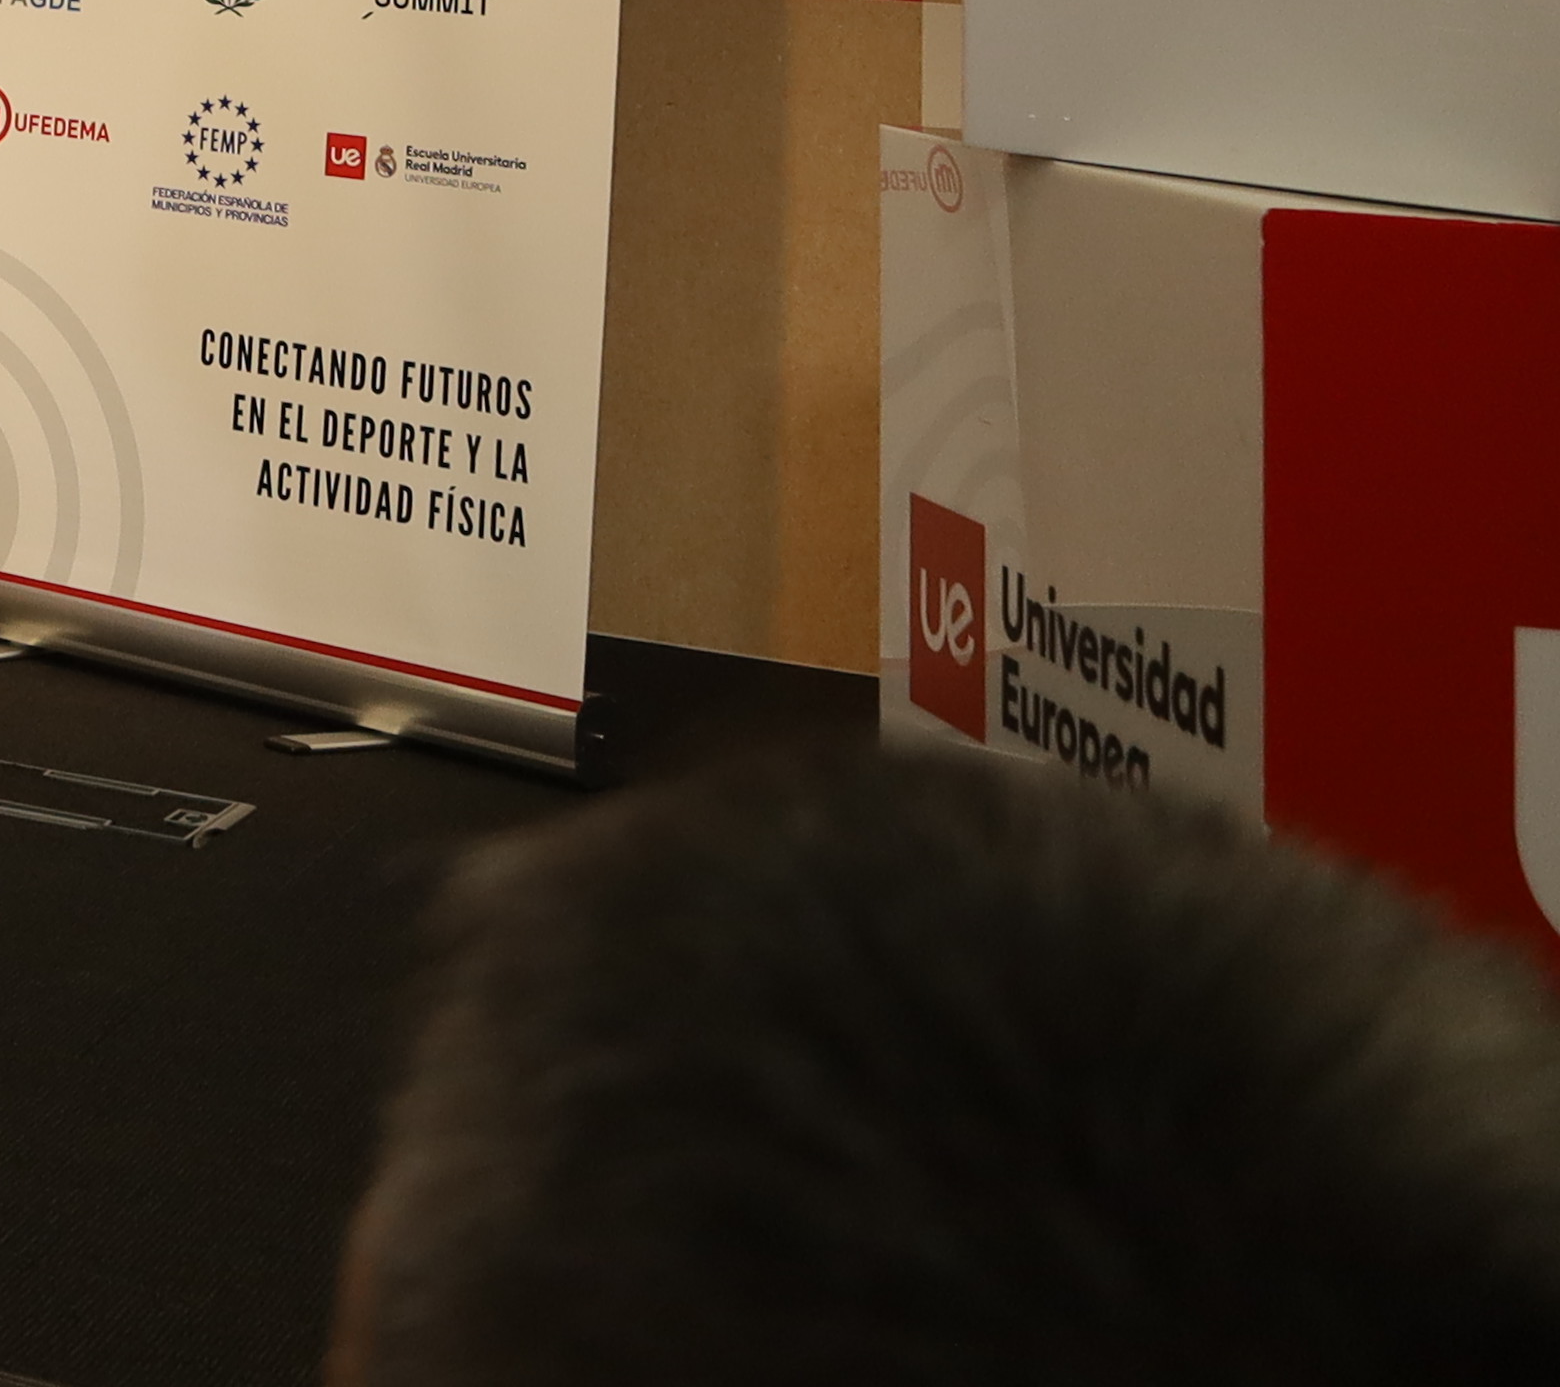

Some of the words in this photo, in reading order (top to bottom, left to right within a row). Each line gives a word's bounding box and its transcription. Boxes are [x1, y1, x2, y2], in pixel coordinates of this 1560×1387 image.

[14, 113, 110, 143] UFEDEMA
[199, 127, 248, 155] FEMP
[331, 146, 361, 167] ue
[405, 159, 430, 172] Real
[432, 163, 473, 178] Madrid
[406, 145, 450, 162] Escuela
[452, 148, 527, 171] Universitaria
[404, 174, 459, 189] UNIVERSIDAD
[461, 180, 502, 194] EUROPEA
[151, 199, 212, 217] MUNICIPIOS
[215, 208, 223, 218] Y
[225, 209, 289, 228] PROVINCIAS
[152, 186, 217, 206] FEDERACIÓN
[218, 194, 273, 214] ESPAÑOLA
[274, 202, 289, 214] DE
[200, 328, 386, 395] CONECTANDO
[401, 359, 533, 420] FUTUROS
[232, 393, 266, 435] EN
[279, 400, 309, 444] EL
[322, 408, 453, 469] DEPORTE
[465, 433, 482, 475] Y
[495, 438, 529, 484] LA
[256, 458, 413, 524] ACTIVIDAD
[428, 485, 526, 548] FÍSICA
[920, 567, 975, 667] ue
[1002, 564, 1226, 752] Universidad
